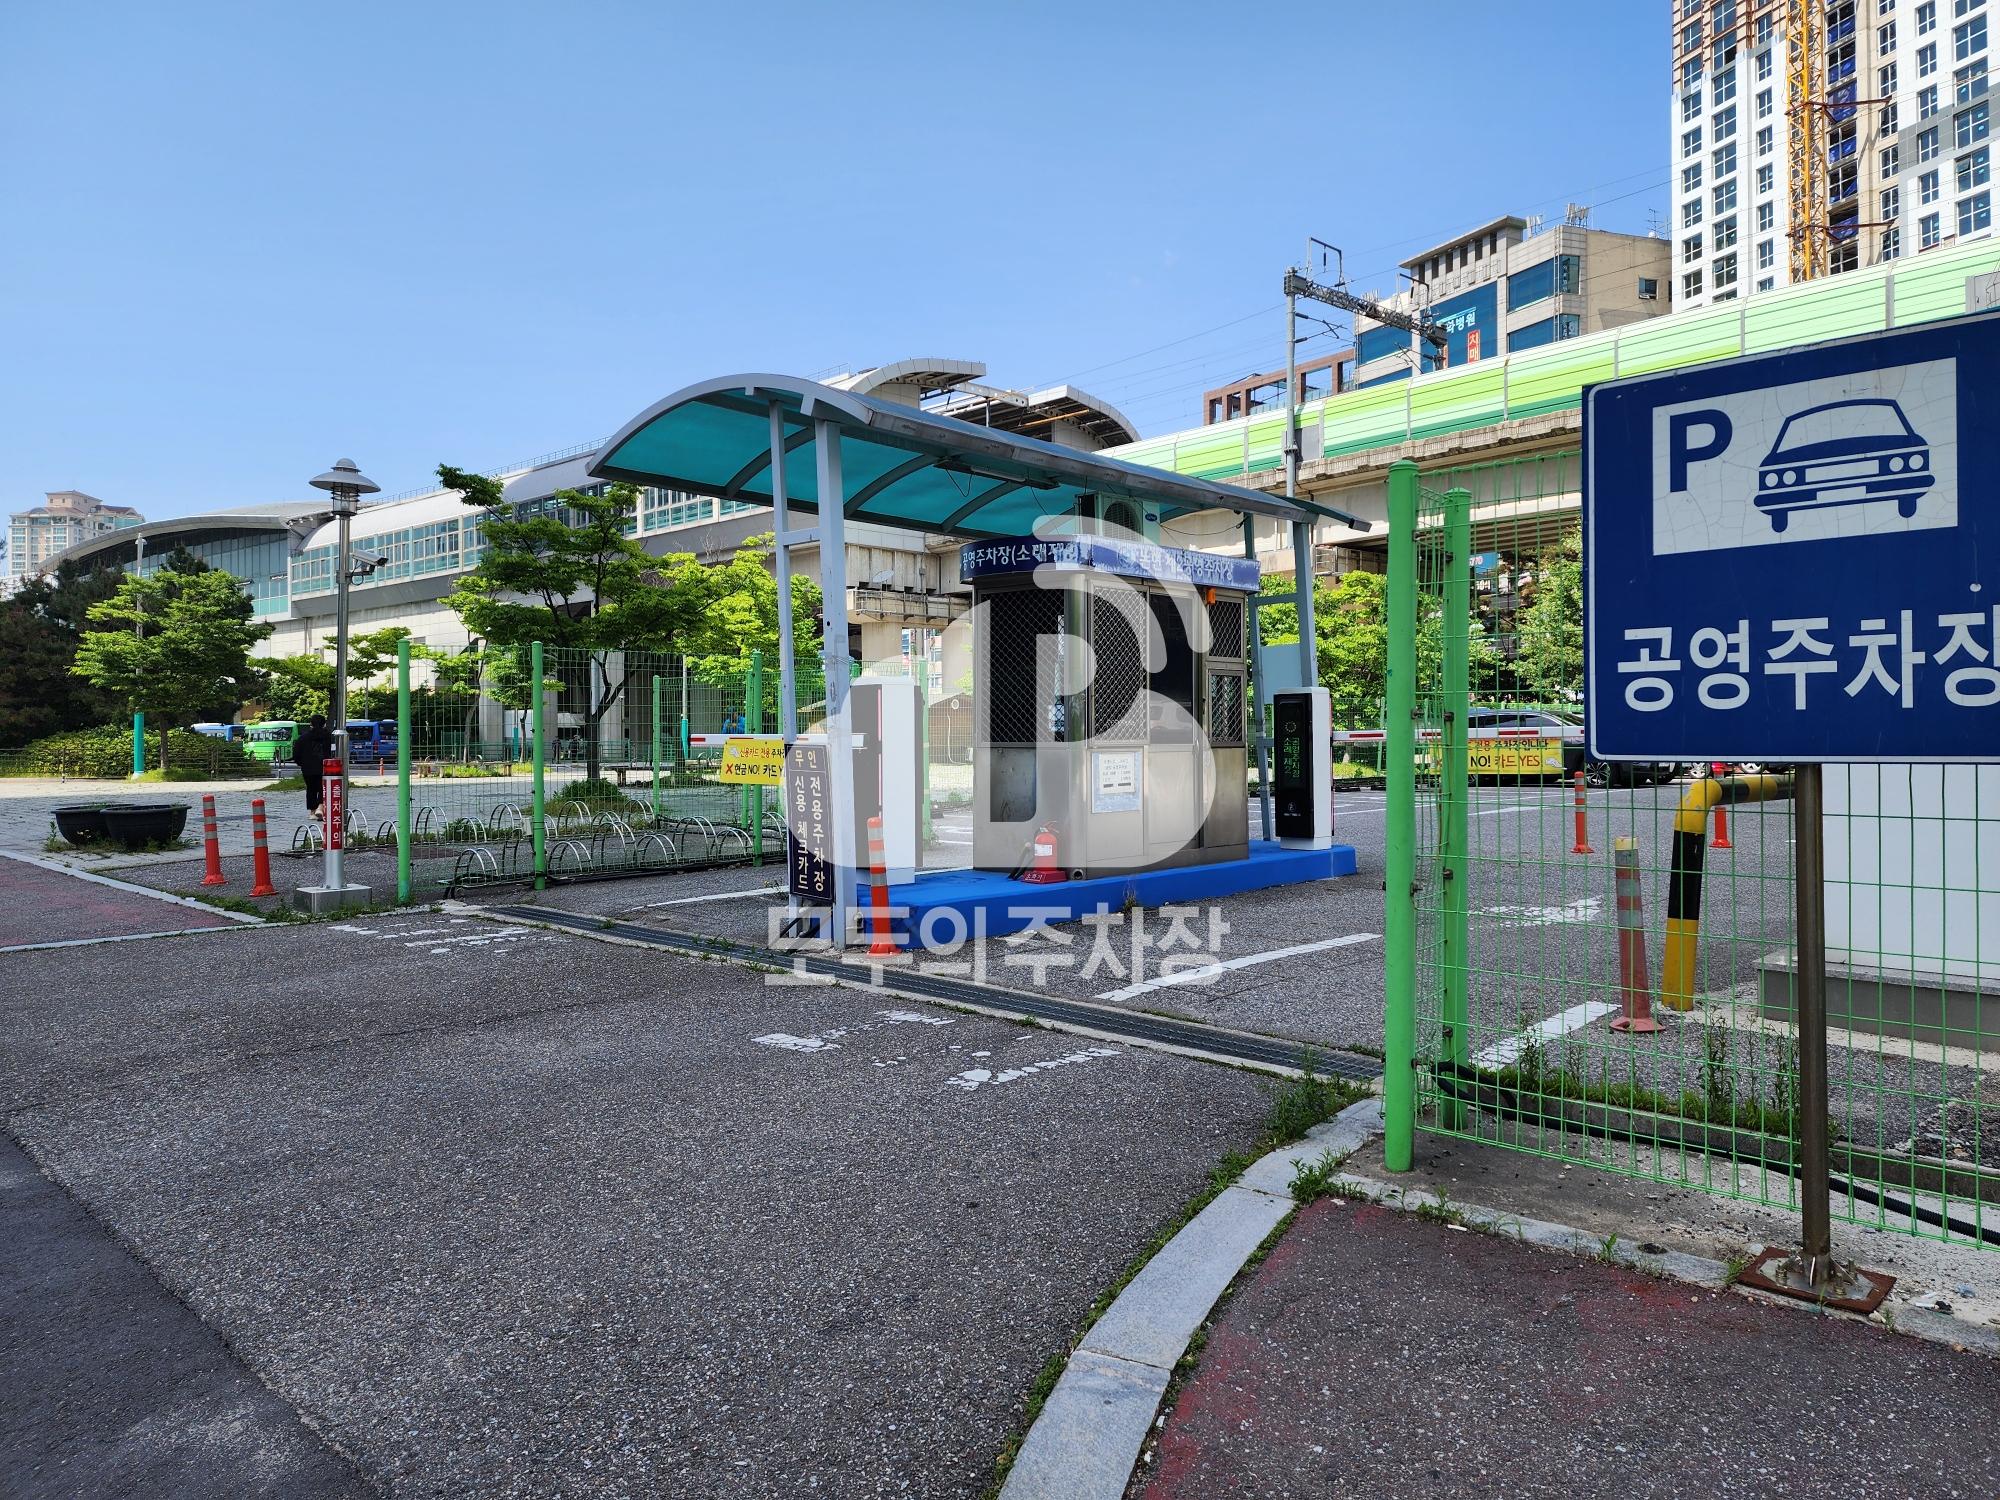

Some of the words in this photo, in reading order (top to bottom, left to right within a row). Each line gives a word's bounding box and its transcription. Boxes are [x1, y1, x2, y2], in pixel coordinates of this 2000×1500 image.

[1669, 409, 1733, 493] P
[1617, 605, 2000, 712] 공영주차장
[762, 764, 777, 778] 카드
[1470, 755, 1491, 768] NO!
[332, 784, 342, 845] 출차주의
[810, 776, 826, 892] 전용주차장
